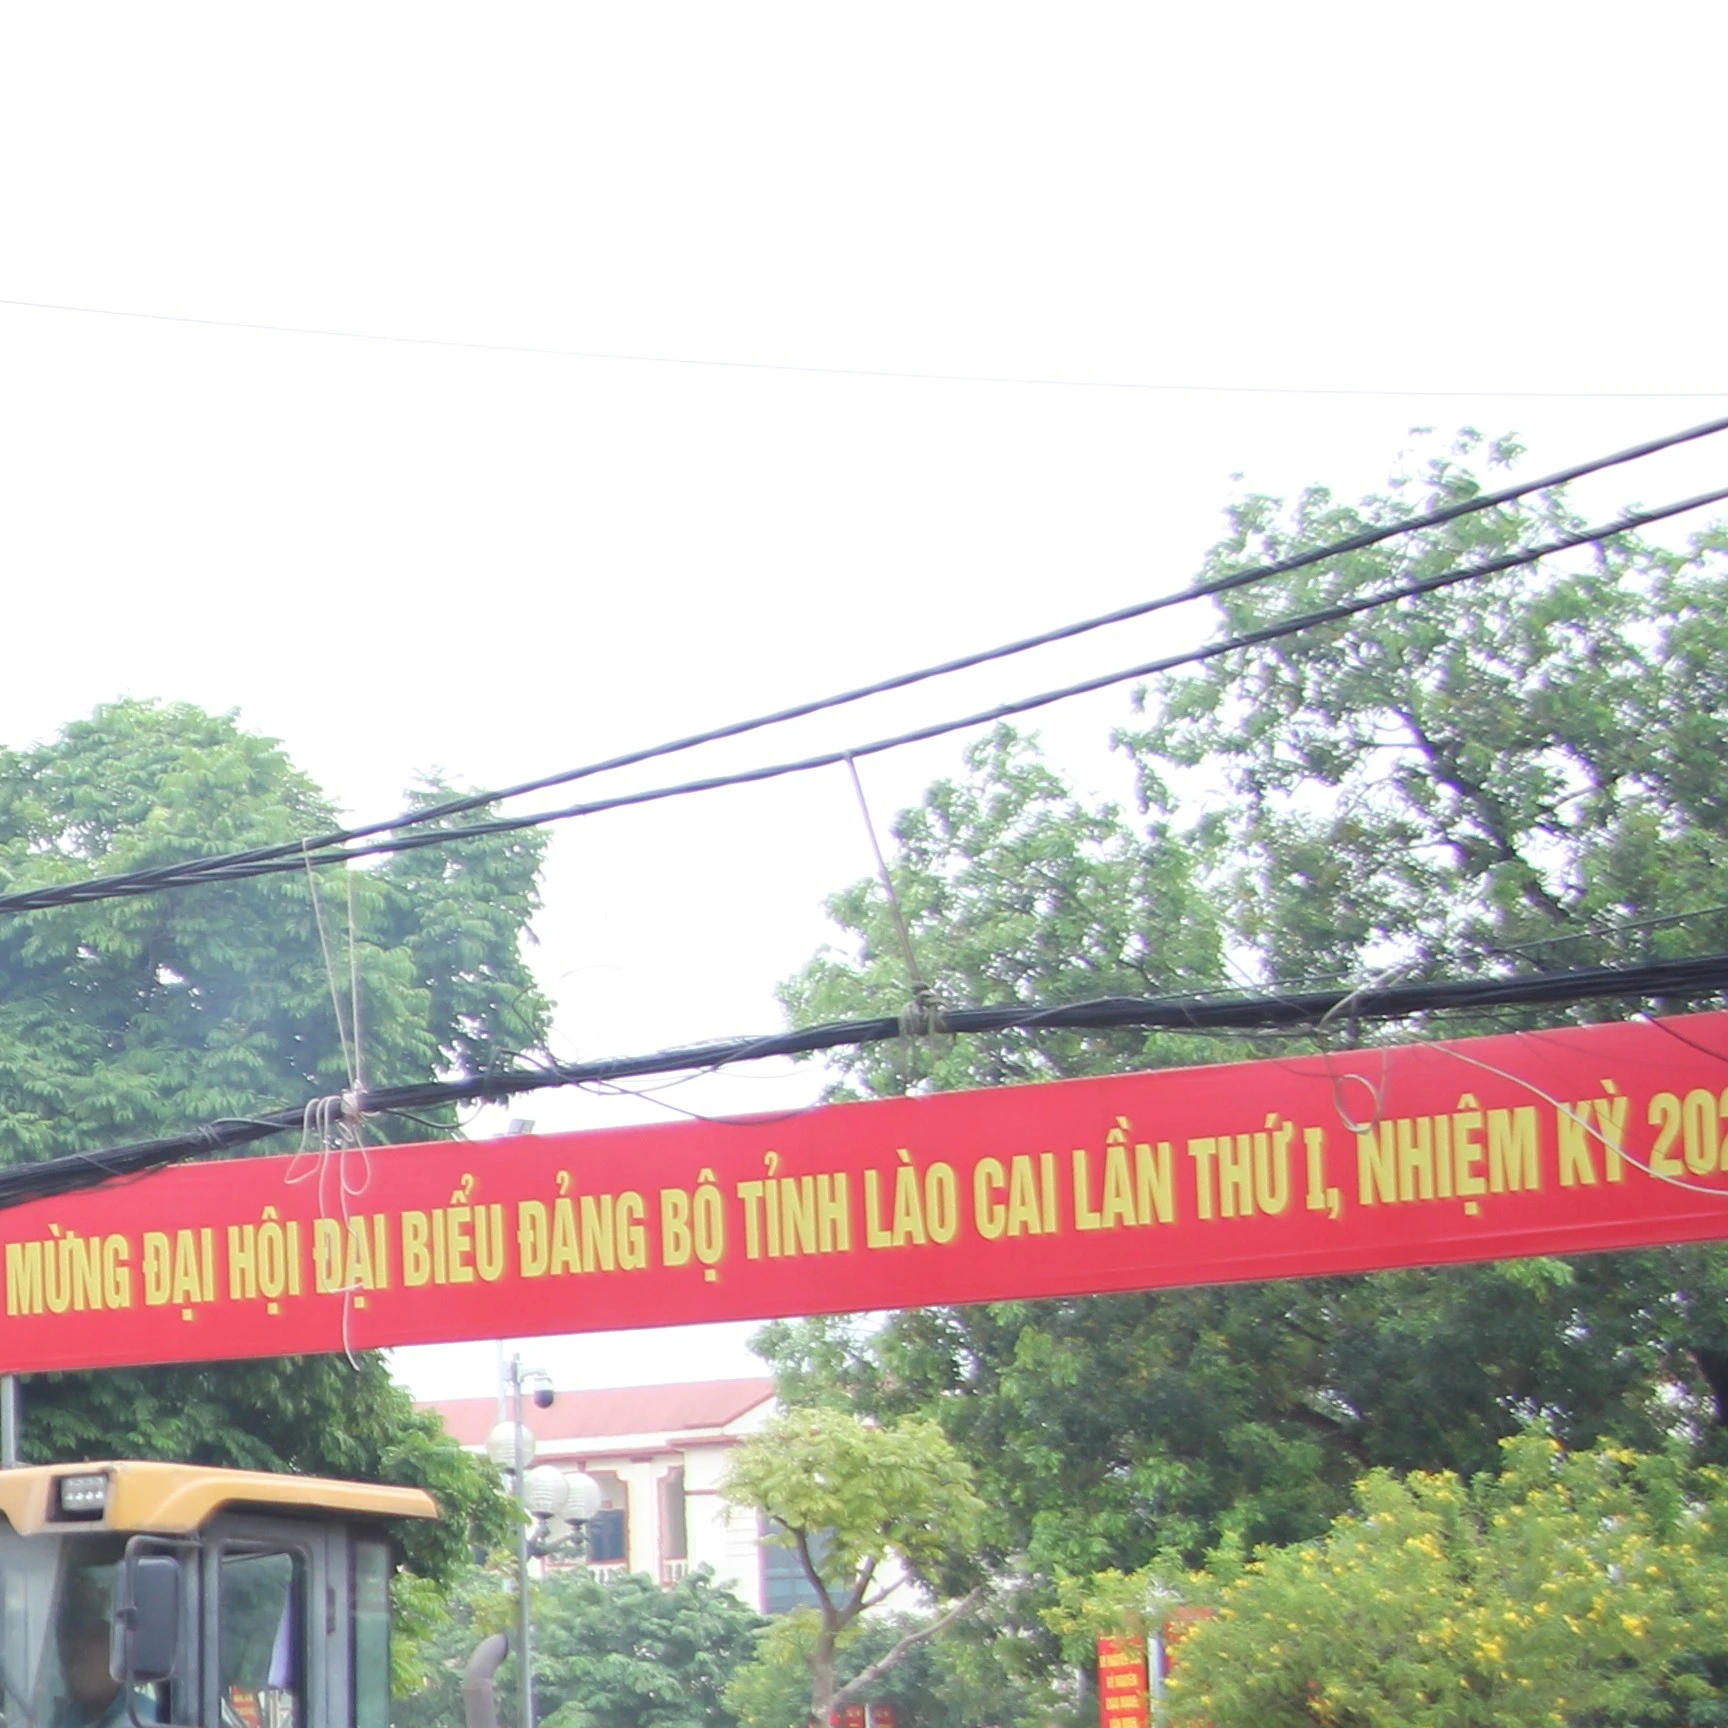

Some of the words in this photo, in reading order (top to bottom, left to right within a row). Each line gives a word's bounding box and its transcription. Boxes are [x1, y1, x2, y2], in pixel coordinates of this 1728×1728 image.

[4, 1222, 133, 1316] MỪNG
[143, 1227, 217, 1321] ĐẠI
[227, 1206, 302, 1315] HỘI
[312, 1213, 390, 1309] ĐẠI
[401, 1173, 506, 1287] BIỂU
[517, 1170, 648, 1278] ĐẢNG
[660, 1168, 726, 1282] BỘ
[737, 1151, 852, 1260] TỈNH
[864, 1148, 959, 1249] LÀO
[973, 1152, 1058, 1240] CAI
[1072, 1115, 1175, 1231] LẦN
[1187, 1112, 1295, 1220] THỨ
[1303, 1127, 1341, 1219] I,
[1356, 1093, 1540, 1216] NHIỆM
[1556, 1078, 1629, 1187] KỲ
[1648, 1087, 1728, 1179] 20
